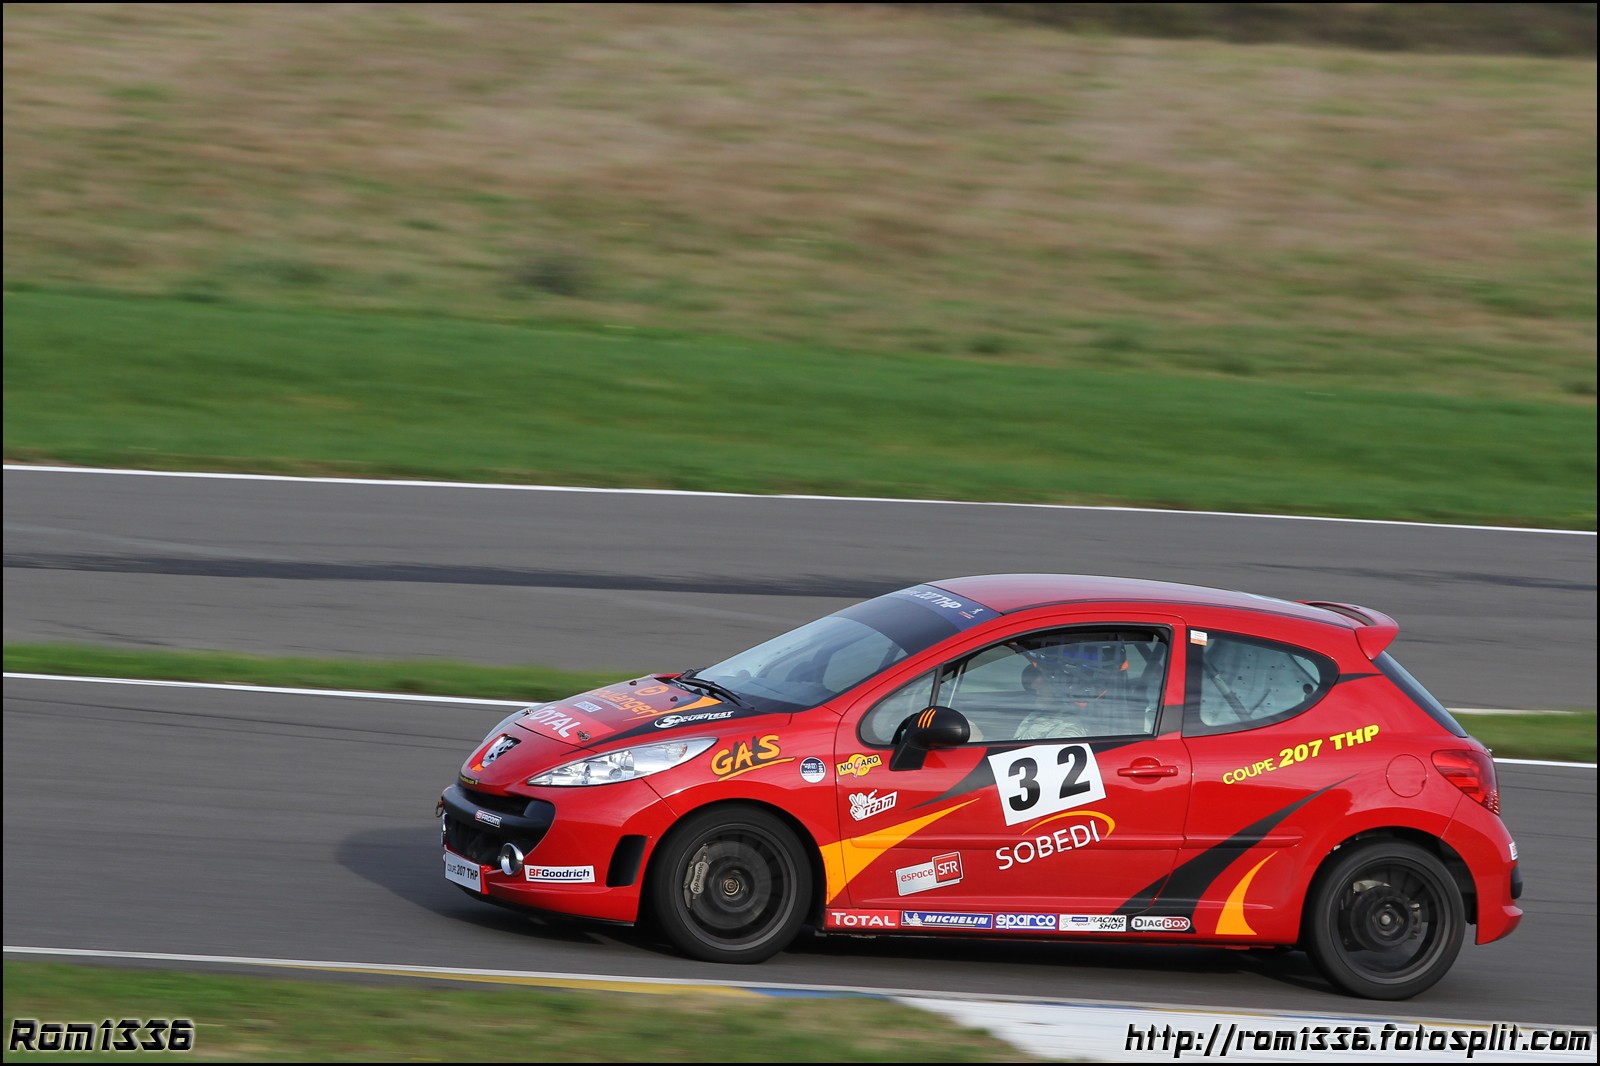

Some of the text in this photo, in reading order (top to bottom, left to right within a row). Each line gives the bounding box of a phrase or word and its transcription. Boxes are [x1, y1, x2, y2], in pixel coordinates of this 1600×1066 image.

[529, 705, 581, 738] TOTAL
[711, 735, 780, 776] GAS
[1222, 724, 1380, 785] COUPE 207 THP
[839, 756, 879, 778] NOGARO
[1008, 745, 1091, 812] 32
[995, 820, 1101, 870] SOBEDI
[456, 864, 466, 877] 207
[466, 867, 479, 881] THP
[528, 868, 590, 878] BFGoodrich
[901, 860, 959, 882] espace SFR
[831, 912, 896, 926] TOTAL
[924, 914, 988, 925] MICHELIN
[995, 914, 1056, 930] sparco
[1090, 916, 1126, 924] RACING
